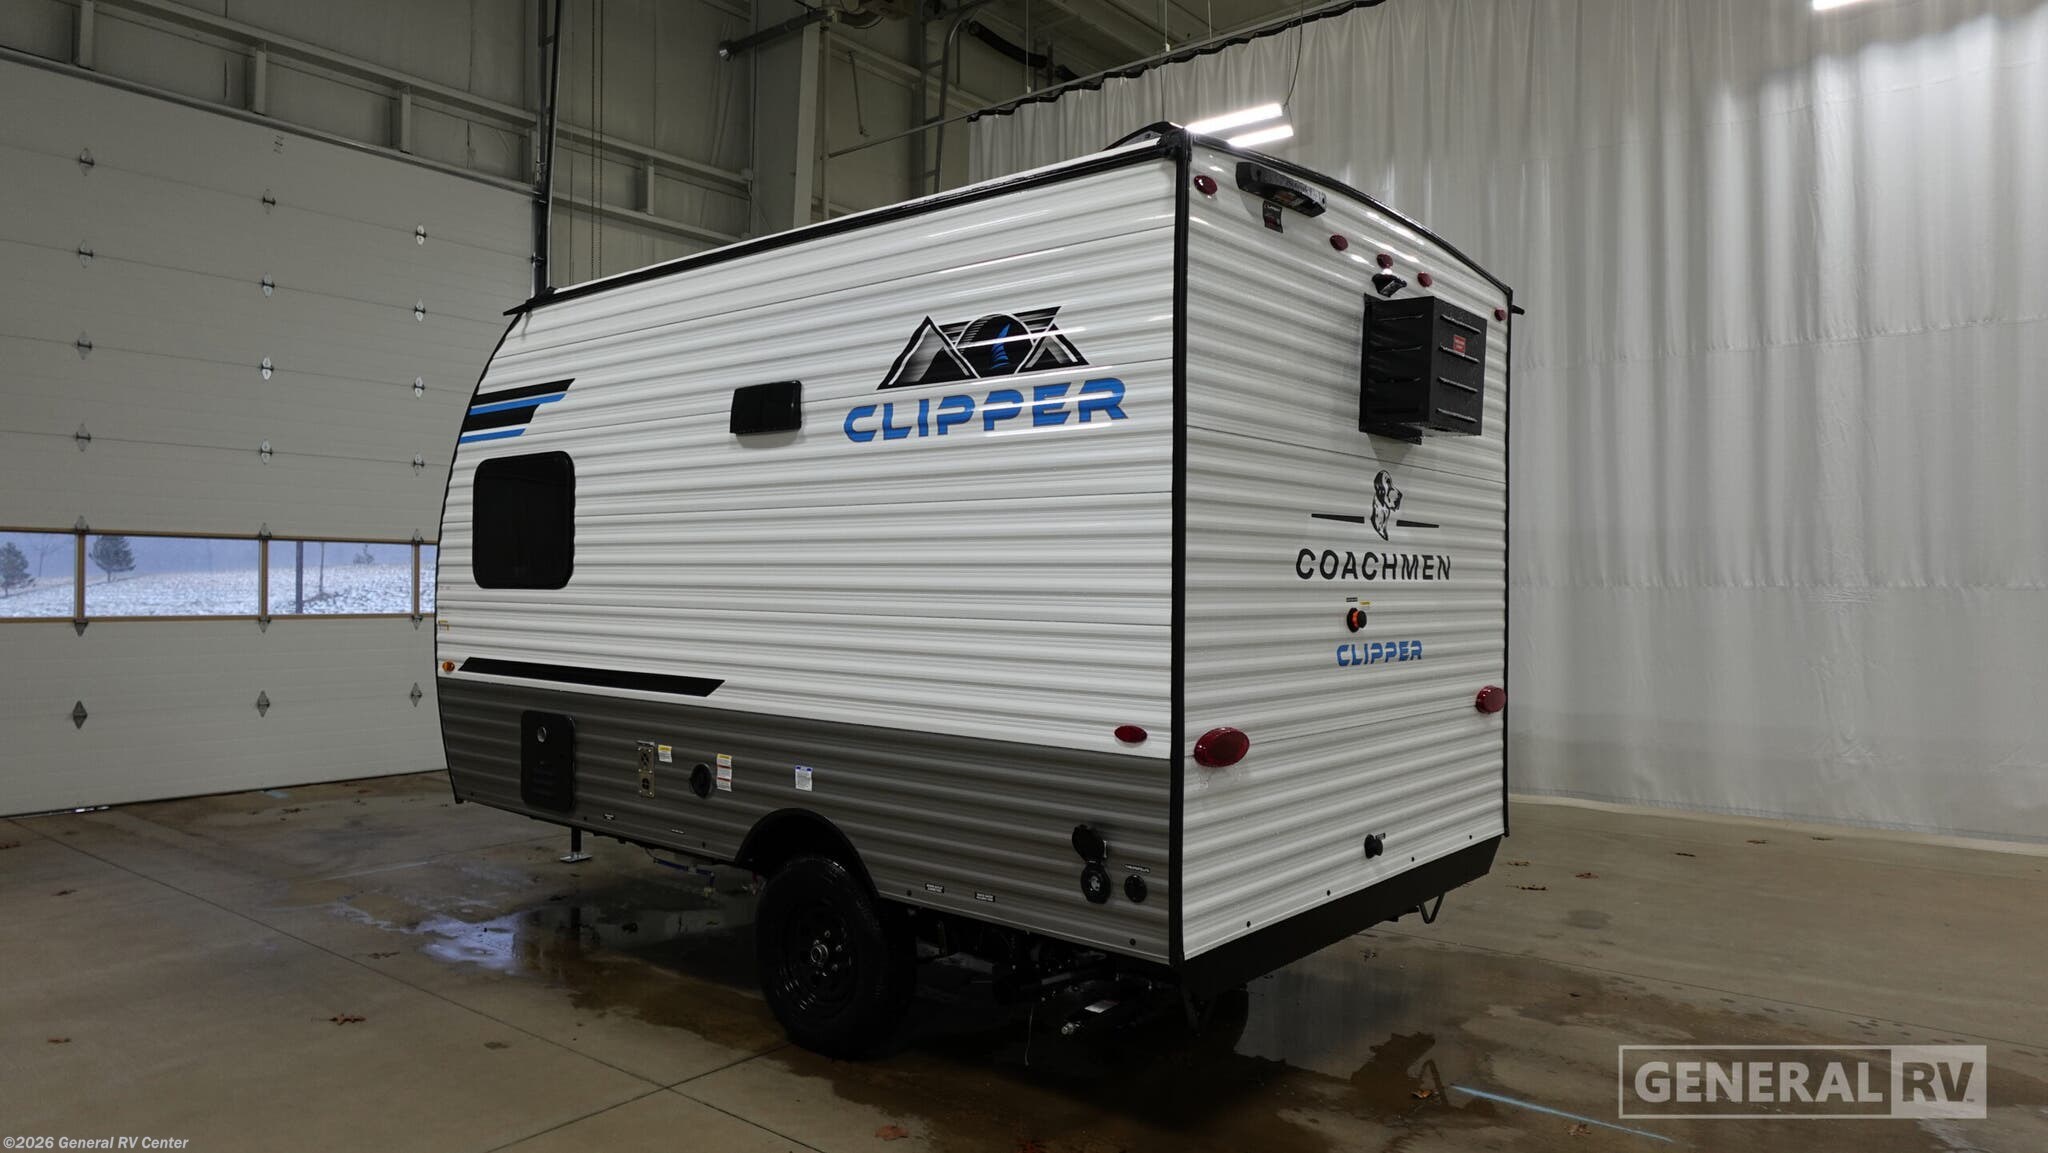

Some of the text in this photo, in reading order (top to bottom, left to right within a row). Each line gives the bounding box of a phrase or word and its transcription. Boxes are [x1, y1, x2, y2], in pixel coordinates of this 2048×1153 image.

[843, 377, 1128, 443] CLIPPER
[1295, 548, 1451, 580] COACHMEN
[1336, 640, 1423, 667] CLIPPER
